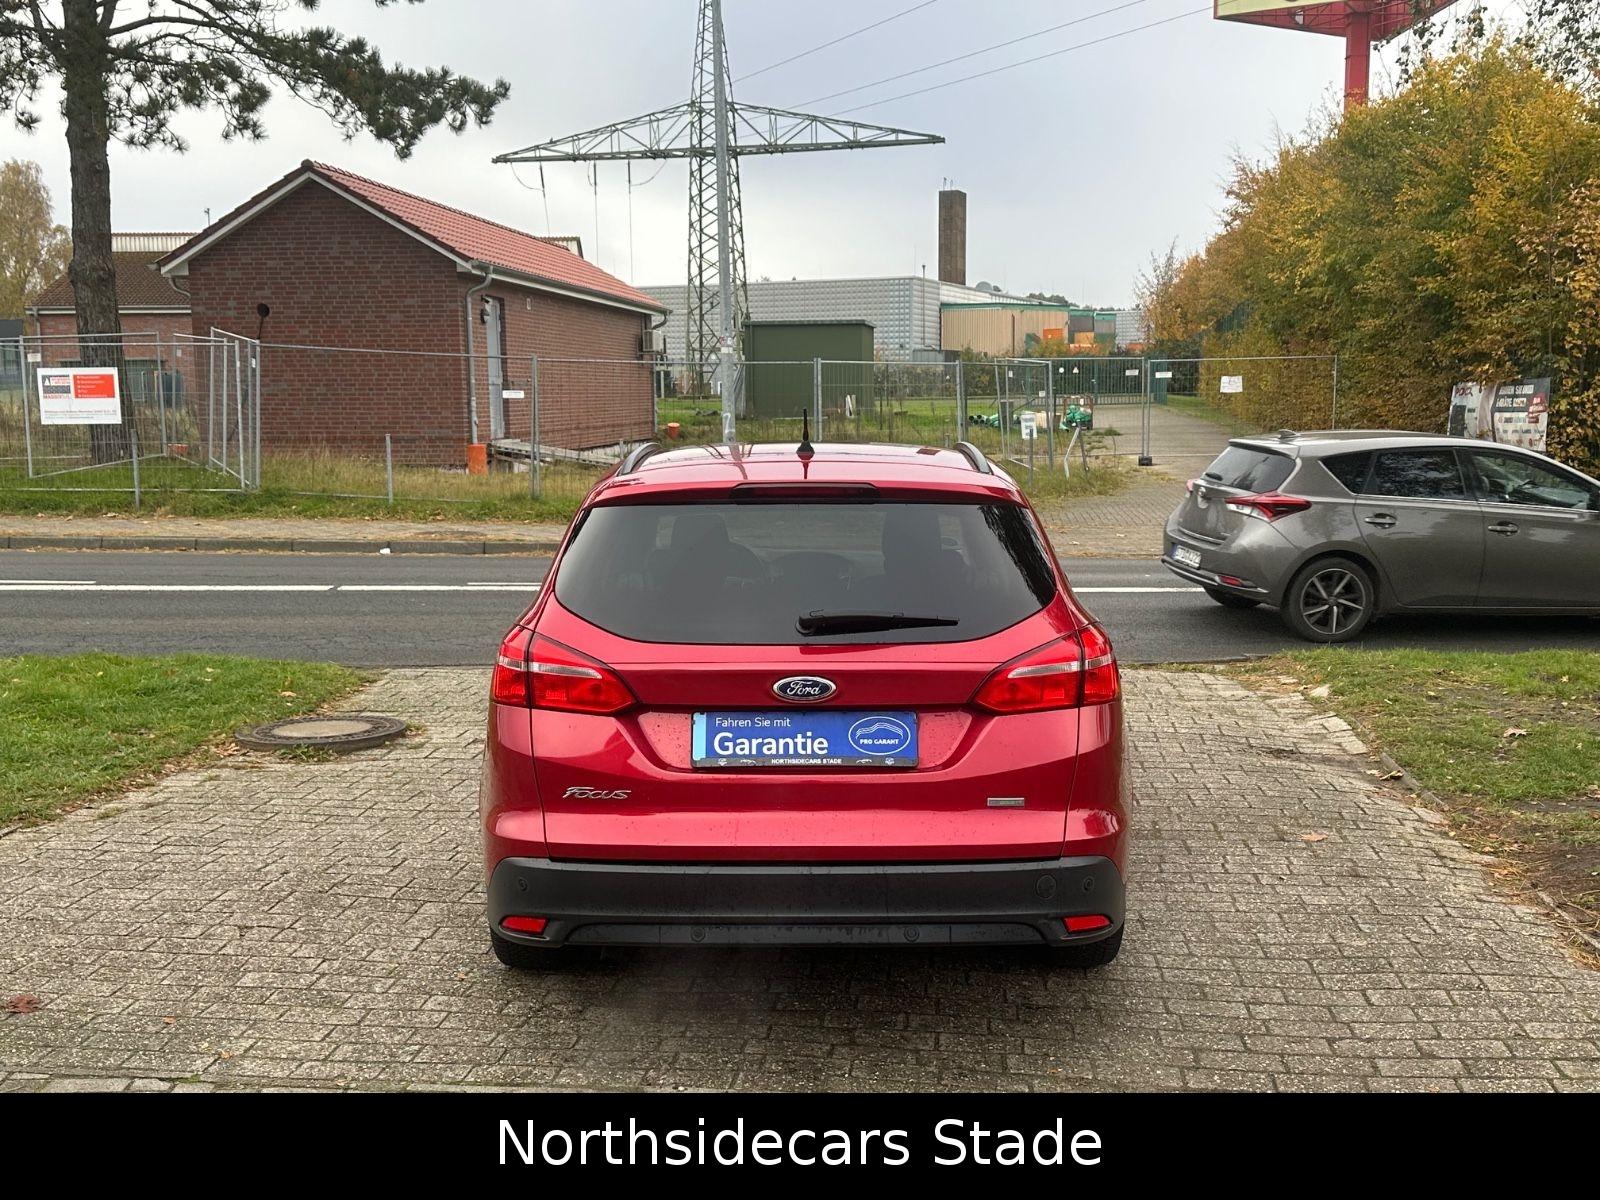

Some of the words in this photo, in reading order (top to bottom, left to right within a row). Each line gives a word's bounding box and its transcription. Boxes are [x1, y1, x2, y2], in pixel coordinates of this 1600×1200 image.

[787, 680, 822, 695] Ford
[715, 717, 751, 727] Fahren
[754, 717, 771, 727] Sie
[773, 717, 791, 727] mit
[714, 732, 828, 755] Garantie
